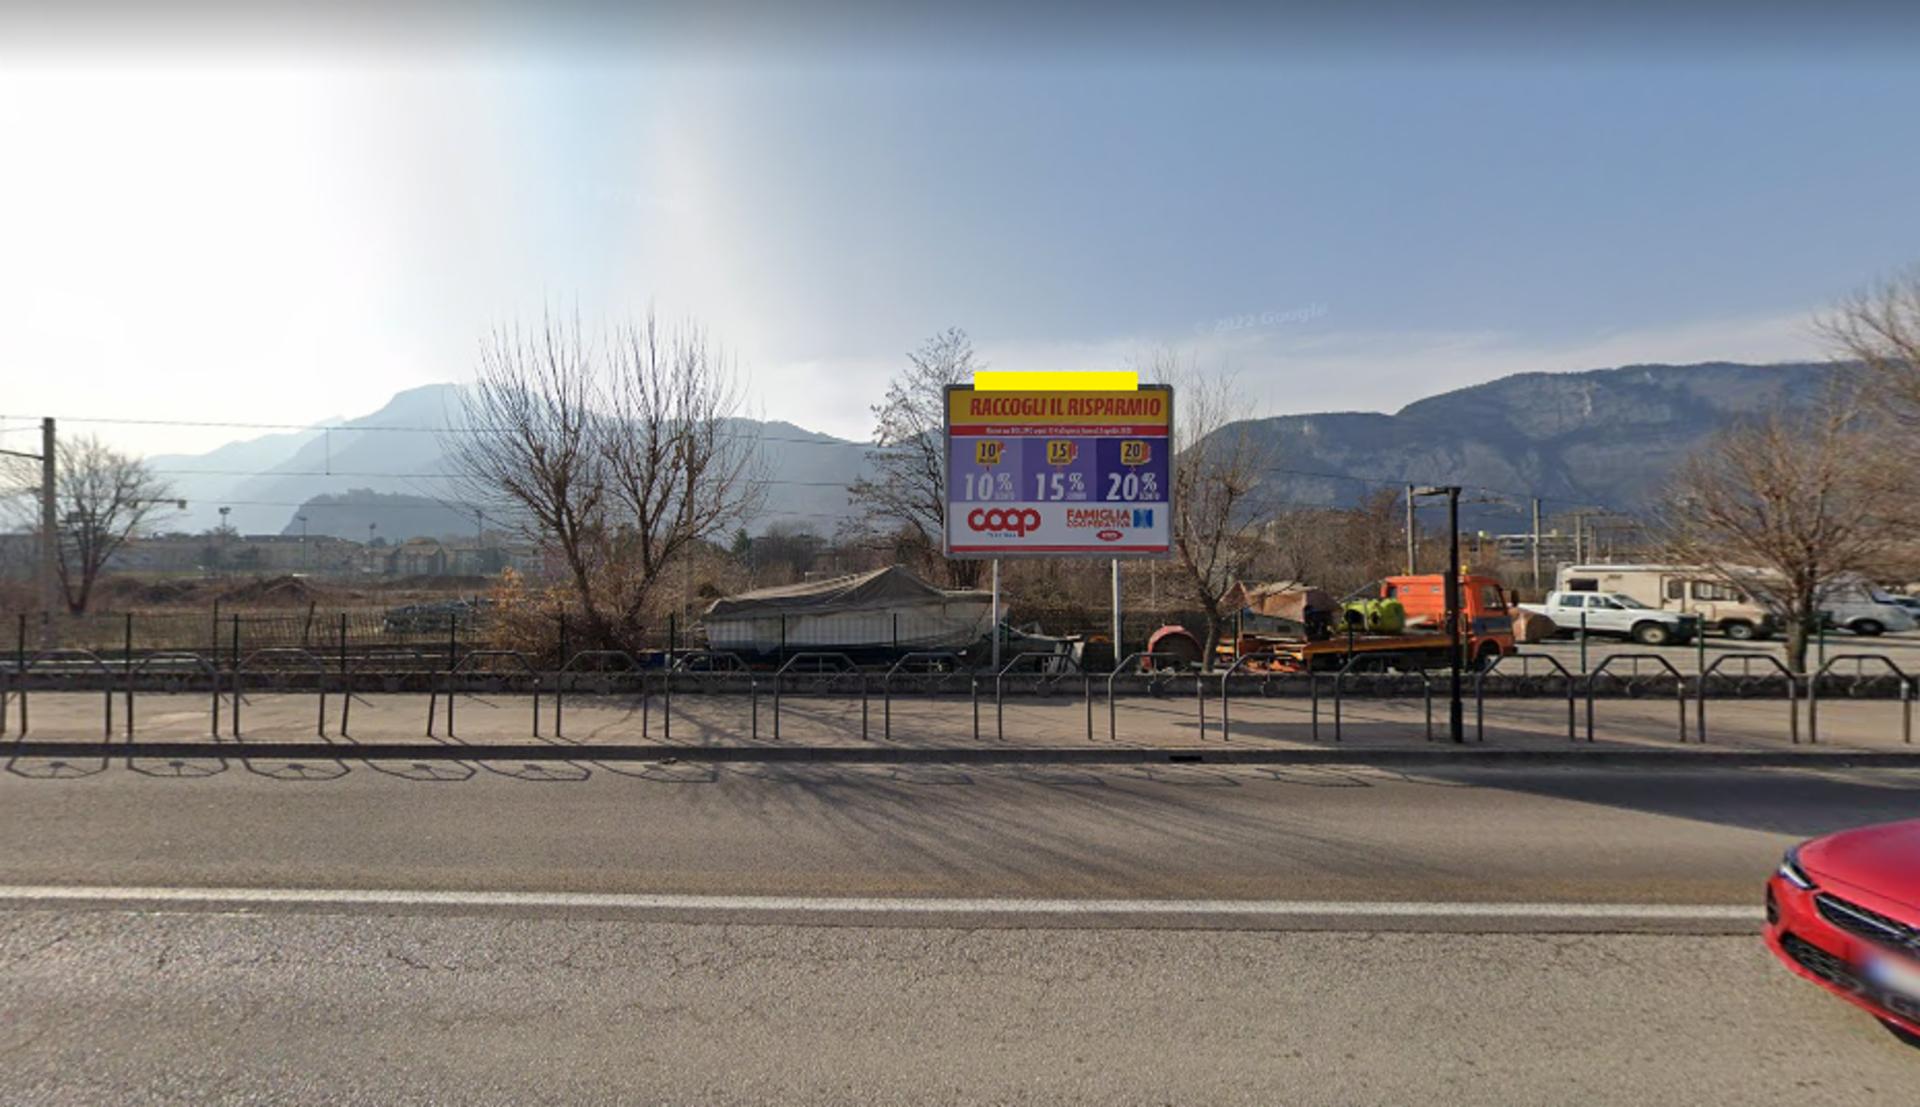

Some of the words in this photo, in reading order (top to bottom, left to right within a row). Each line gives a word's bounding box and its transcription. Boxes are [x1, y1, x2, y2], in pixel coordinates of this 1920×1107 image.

[970, 398, 1046, 416] RACCOGLI
[1050, 398, 1064, 416] IL
[1067, 398, 1161, 416] RISPARMIO
[980, 444, 996, 456] 10
[1051, 444, 1066, 457] 15
[1124, 444, 1140, 457] 20
[1066, 508, 1130, 520] FAMIGLIA
[968, 508, 1041, 537] coop
